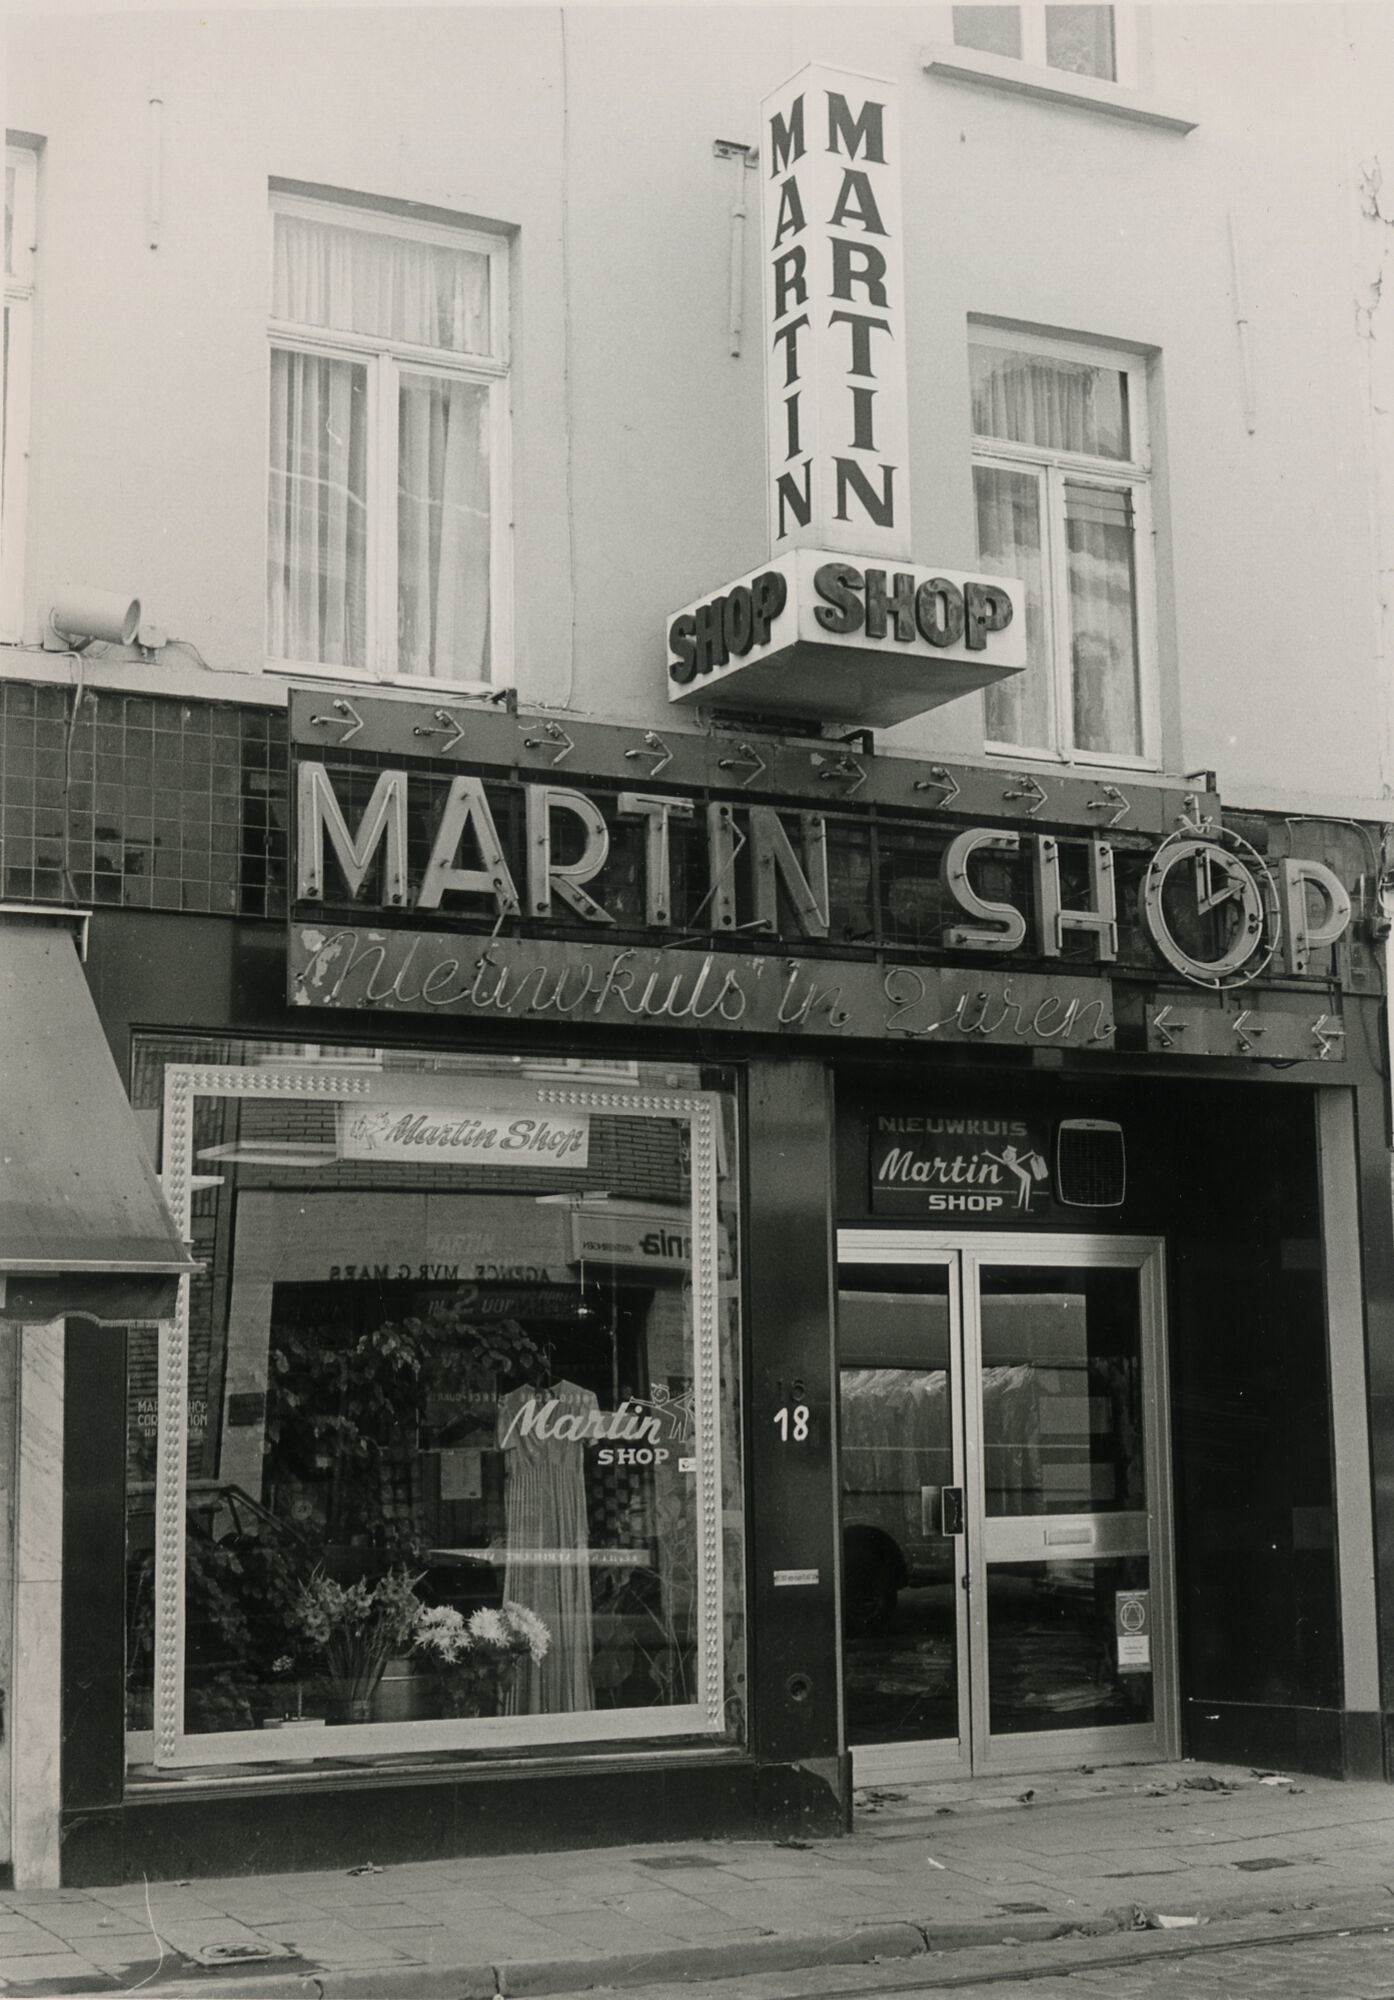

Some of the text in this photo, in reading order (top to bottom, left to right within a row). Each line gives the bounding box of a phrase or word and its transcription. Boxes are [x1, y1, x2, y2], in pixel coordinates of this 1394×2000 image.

[768, 90, 813, 541] MARTIN
[824, 90, 899, 529] MARTIN
[669, 570, 787, 685] SHOP
[813, 561, 1013, 651] SHOP
[297, 760, 1351, 978] MARTIN SHOP
[384, 1112, 584, 1158] Martin Shop
[878, 1115, 1028, 1137] NIEUWKUIS
[878, 1147, 1004, 1185] Martin
[928, 1193, 1004, 1212] SHOP
[501, 1398, 662, 1449] Martin
[773, 1404, 810, 1443] 18
[597, 1447, 670, 1466] SHOP
